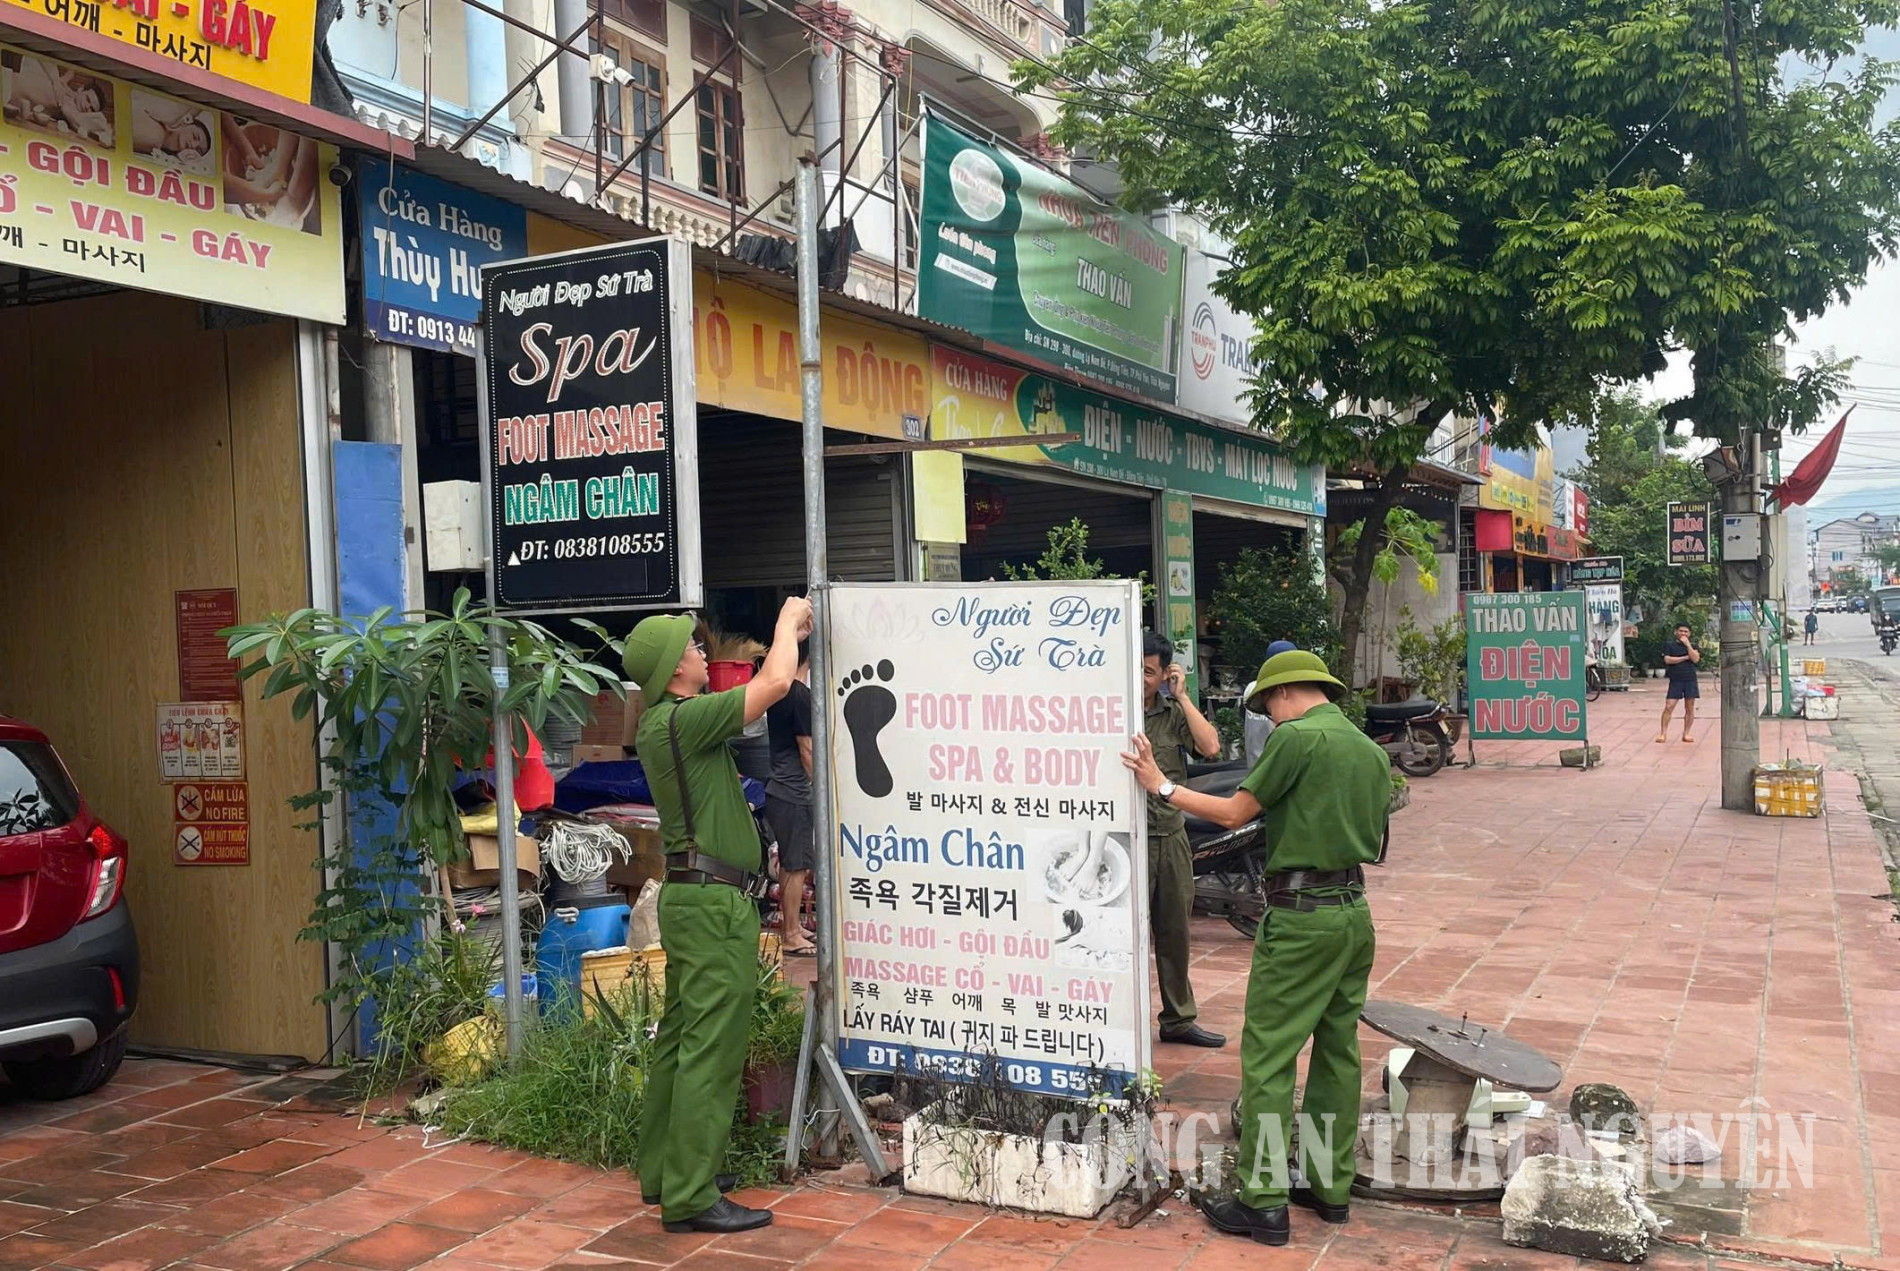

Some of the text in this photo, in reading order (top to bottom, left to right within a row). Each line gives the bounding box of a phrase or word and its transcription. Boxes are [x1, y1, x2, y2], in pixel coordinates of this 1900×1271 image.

[136, 22, 212, 70] 마사지
[27, 141, 110, 187] GỘI
[125, 168, 215, 211] ĐẦU
[70, 200, 144, 243] VAI
[191, 230, 271, 269] GÁY
[378, 187, 503, 252] Cửa Hàng
[0, 224, 23, 248] 깨
[62, 238, 145, 273] 마사지
[373, 226, 441, 303] Thùy
[499, 268, 653, 317] Người Đẹp Sứ Trà
[388, 309, 414, 335] ĐT:
[417, 315, 454, 345] 0913
[508, 323, 657, 403] Spa
[752, 323, 802, 395] LA
[835, 341, 924, 420] ĐỘNG
[945, 358, 1008, 401] CỬA HÀNG
[498, 401, 665, 466] FOOT MASSAGE
[905, 418, 920, 438] 302
[1084, 401, 1121, 460] ĐIỆN
[1136, 416, 1174, 465] NƯỚC
[1185, 432, 1215, 474] TBVS
[1225, 439, 1248, 481] MÁY
[1251, 452, 1271, 491] LỌC
[504, 466, 660, 525] NGÂM CHÂN
[521, 533, 665, 561] ĐT: 0838108555
[931, 594, 1122, 639] Người Đẹp
[1472, 597, 1577, 633] THAO VẤN
[1501, 594, 1520, 605] 300
[1523, 594, 1542, 605] 185
[972, 637, 1106, 675] Sứ Trà
[1479, 638, 1571, 688] ĐIỆN
[904, 692, 1124, 734] FOOT MASSAGE
[1474, 691, 1580, 733] NƯỚC
[928, 743, 1101, 788] SPA & BODY
[206, 806, 245, 820] NO FIRE
[906, 791, 1115, 821] 발 마사지 & 전신 마사지
[204, 845, 246, 858] NO SMOKING
[840, 824, 1025, 873] Ngâm Chân
[849, 876, 1018, 921] 족욕 각질제거
[843, 919, 893, 946] GIÁC
[900, 925, 936, 950] HƠI
[958, 928, 997, 957] GỘI
[1003, 930, 1050, 960] ĐẦU
[843, 957, 947, 988] MASSAGE
[954, 960, 985, 991] CỔ
[1008, 973, 1043, 998] VAI
[1066, 976, 1114, 1004] GÁY
[850, 981, 1108, 1025] 족욕 샴푸 어깨 목 발 맛사지
[843, 1003, 875, 1031] LẤY
[880, 1009, 915, 1036] RÁY
[920, 1018, 946, 1039] TAI
[1000, 1024, 1018, 1050] 파
[1007, 1064, 1042, 1086] 08
